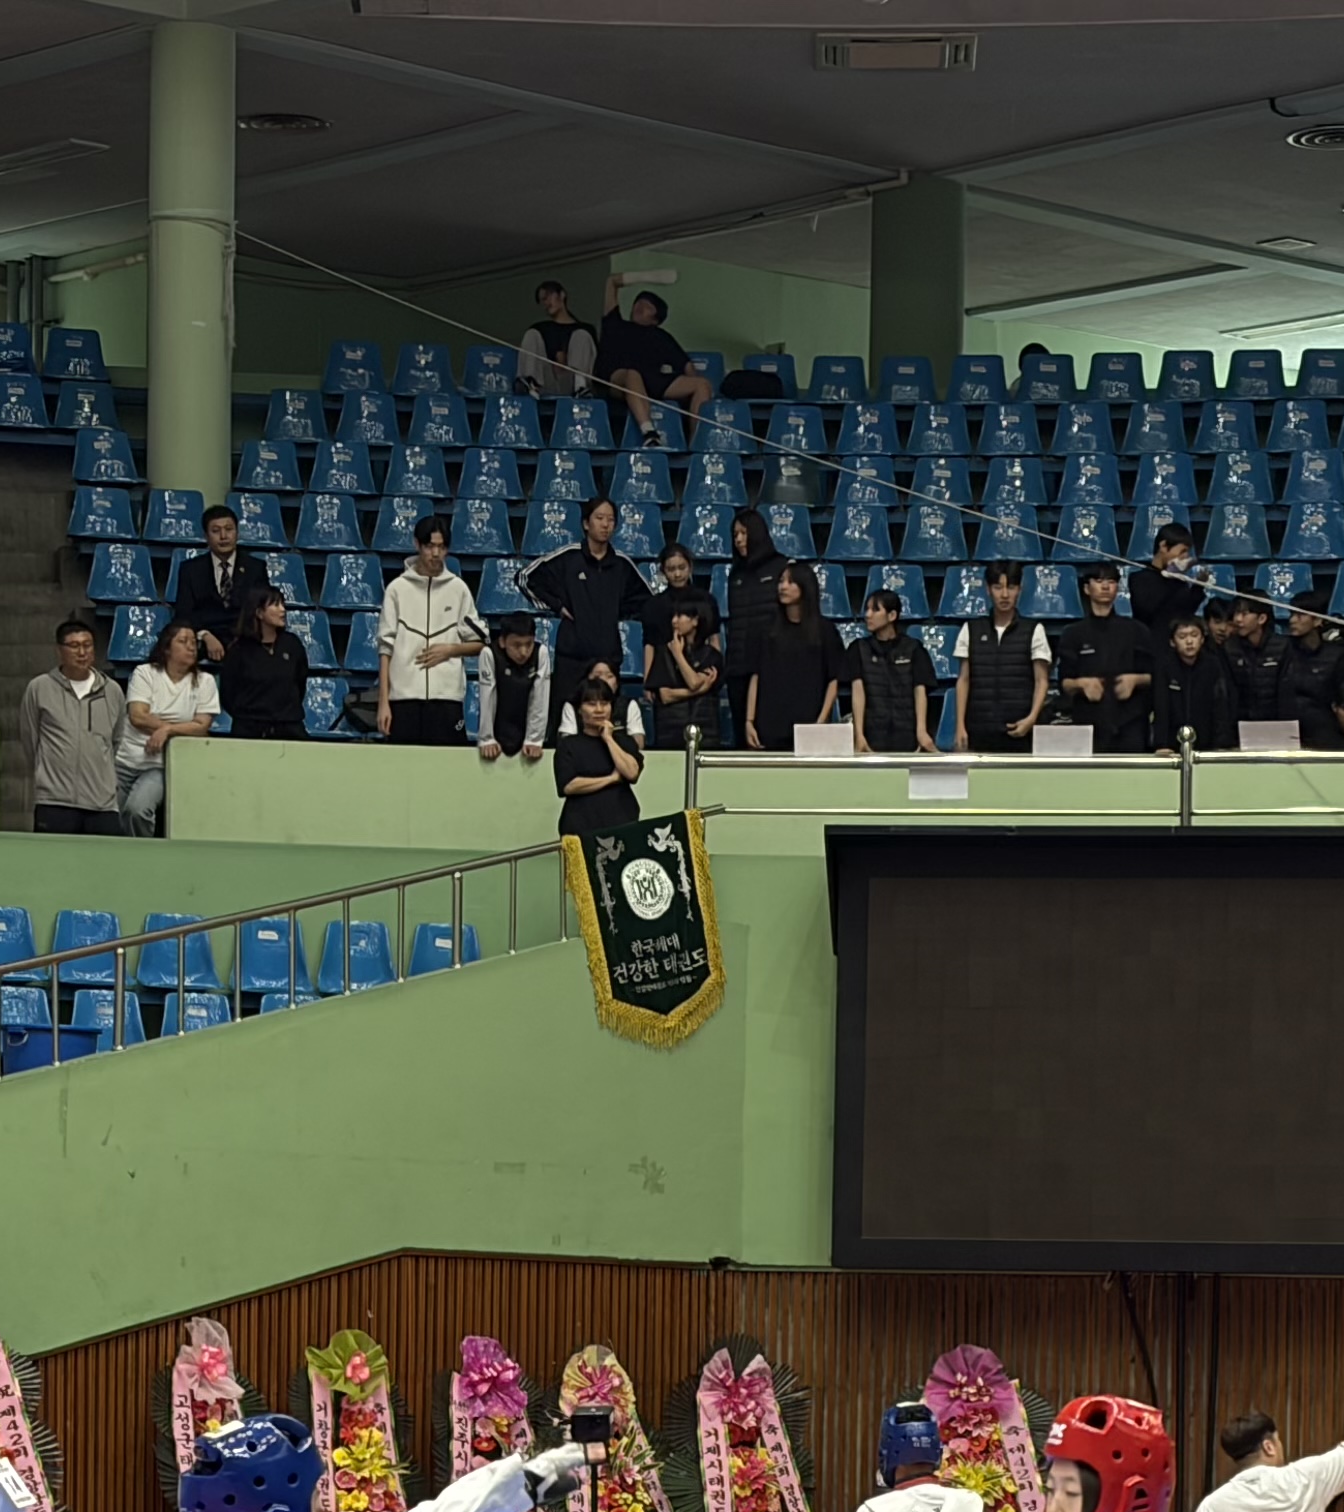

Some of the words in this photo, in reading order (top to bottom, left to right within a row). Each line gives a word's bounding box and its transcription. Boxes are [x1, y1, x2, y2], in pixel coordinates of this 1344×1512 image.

[612, 957, 660, 985] 건강한
[662, 947, 708, 975] 태권도
[0, 1405, 29, 1459] 제42회
[1008, 1443, 1034, 1492] 제42회
